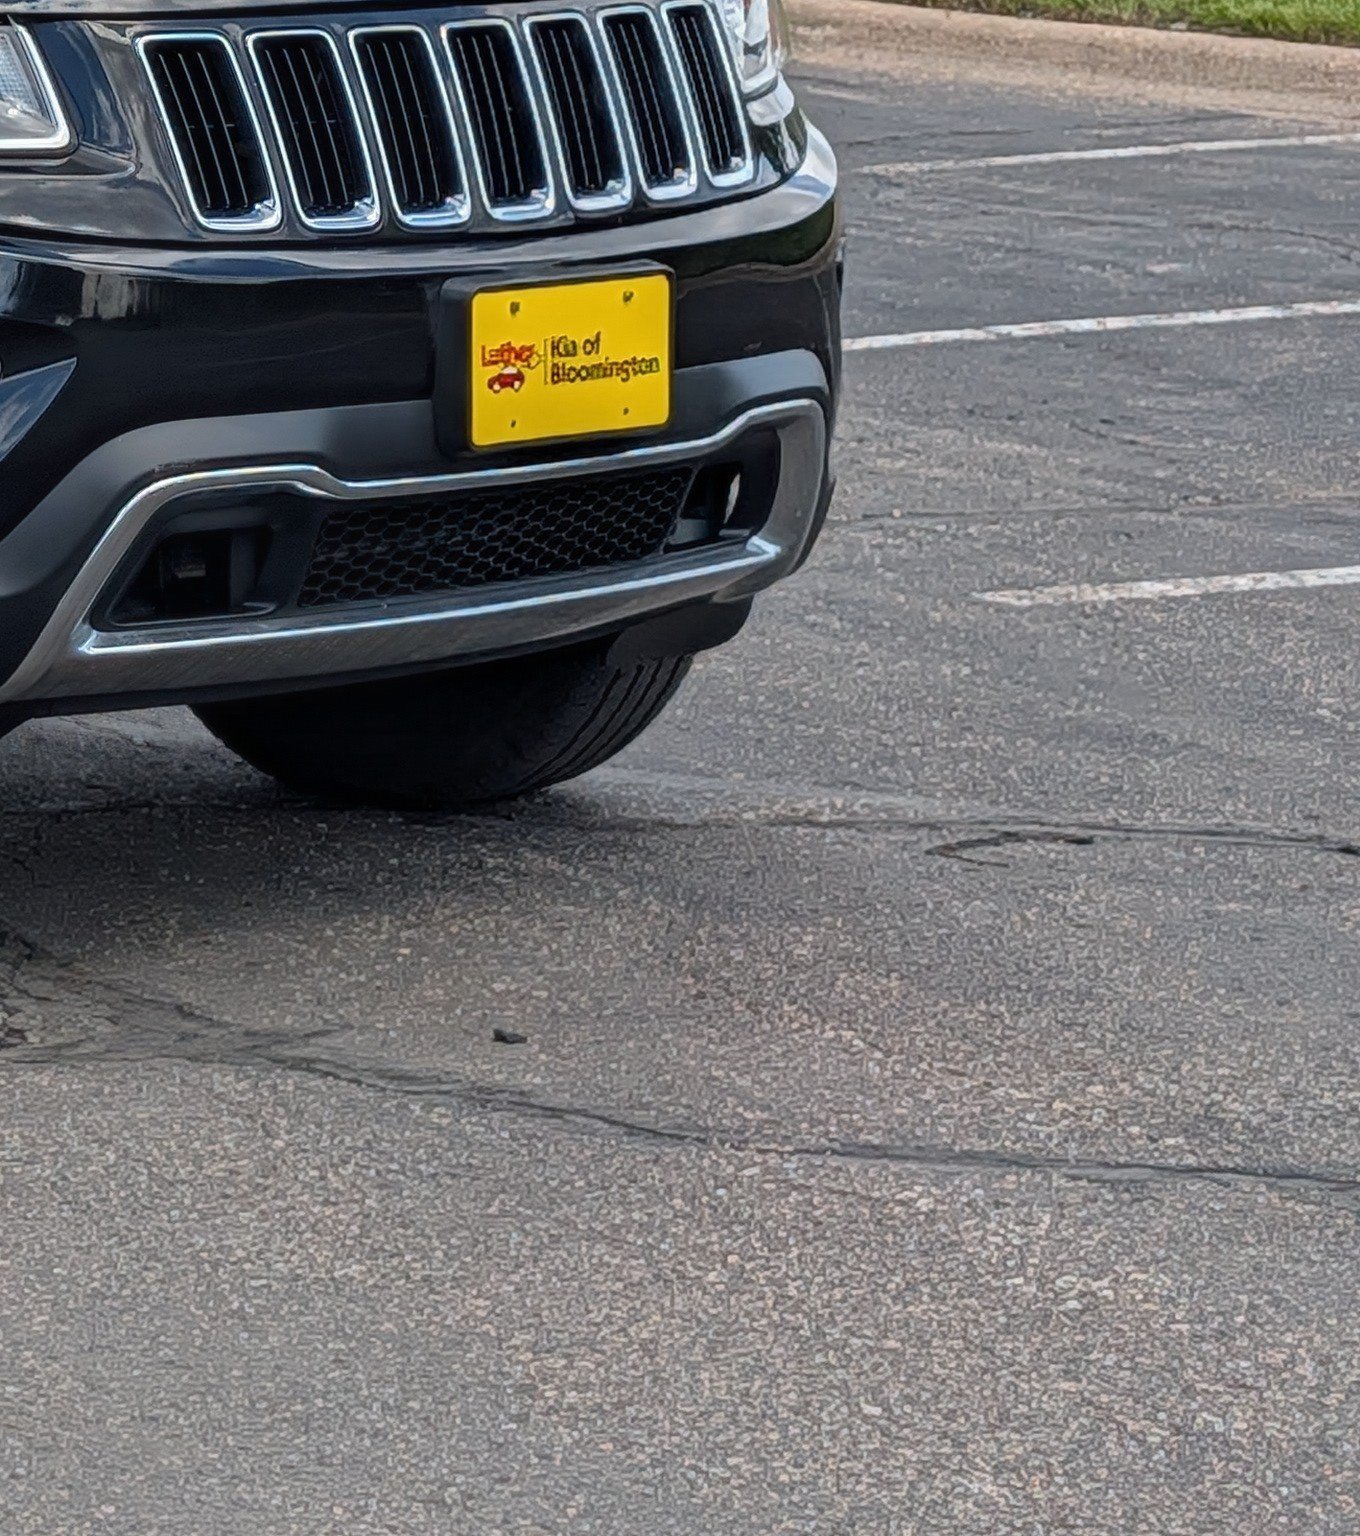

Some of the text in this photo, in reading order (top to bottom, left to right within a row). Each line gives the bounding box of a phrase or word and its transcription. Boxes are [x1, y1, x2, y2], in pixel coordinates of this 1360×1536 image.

[551, 331, 601, 358] Kia of
[551, 356, 660, 385] Bloomington
